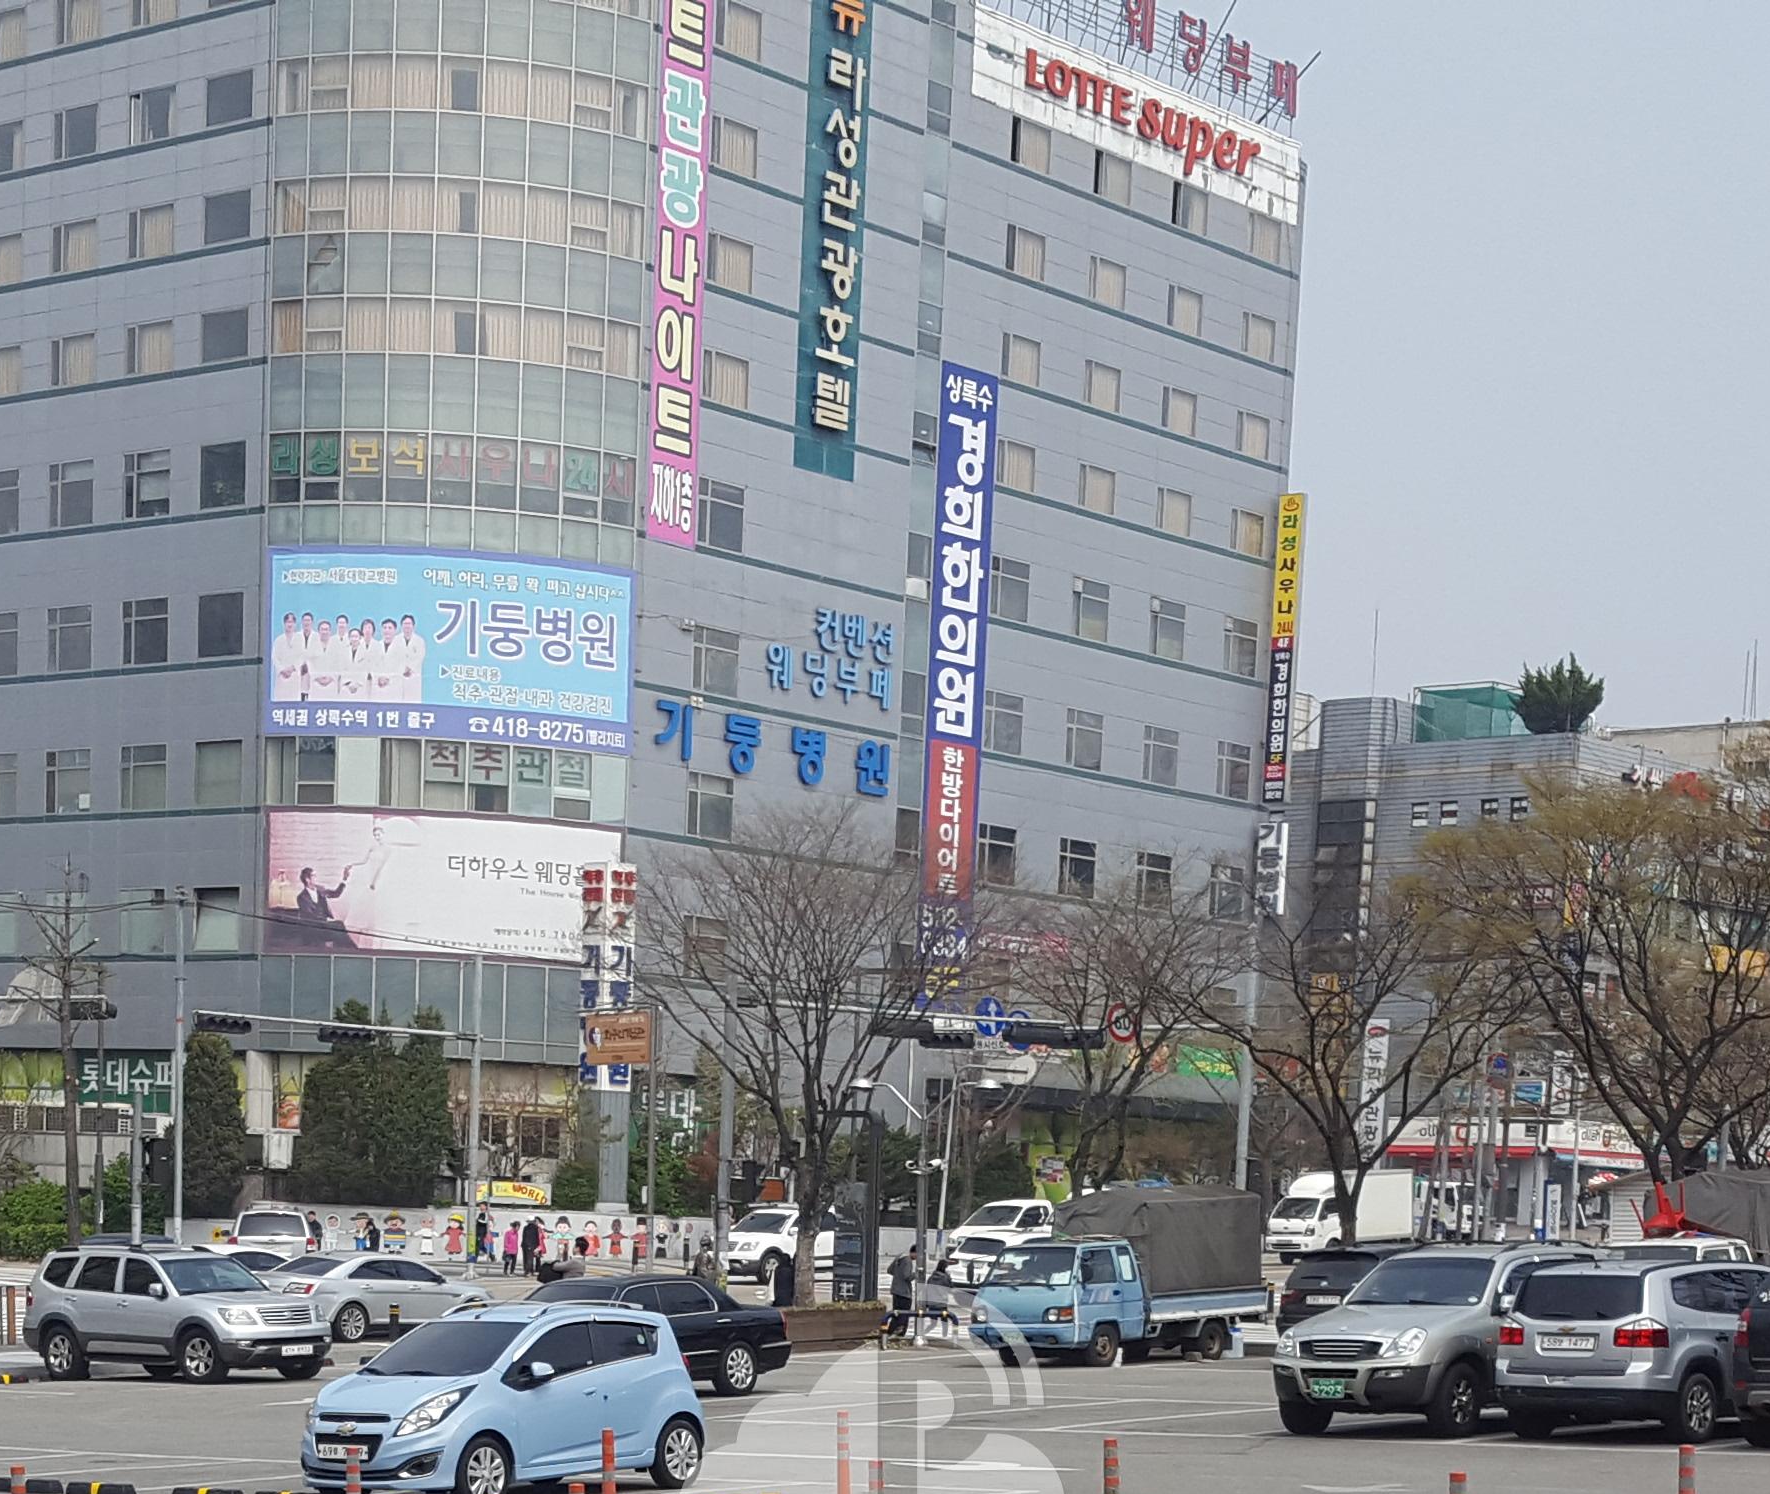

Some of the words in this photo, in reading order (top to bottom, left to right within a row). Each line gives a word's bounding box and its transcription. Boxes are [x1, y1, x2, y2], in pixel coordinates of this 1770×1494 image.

[1024, 47, 1133, 126] LOTTE
[655, 229, 699, 459] 나이트
[946, 374, 994, 411] 상록수
[652, 463, 693, 534] 지하1층
[458, 572, 490, 590] 허리,
[932, 414, 988, 739] 경희한의원
[434, 599, 618, 671] 기둥병원
[816, 607, 894, 664] 컨벤션
[452, 665, 502, 683] 진료내용
[767, 642, 893, 711] 웨딩부페
[376, 711, 400, 729] 1번
[407, 712, 436, 730] 출구
[558, 692, 613, 717] 건강검진
[492, 716, 584, 745] 418-8275
[655, 698, 891, 799] 기둥병원
[447, 855, 529, 880] 더하우스
[82, 1057, 175, 1096] 롯데슈퍼
